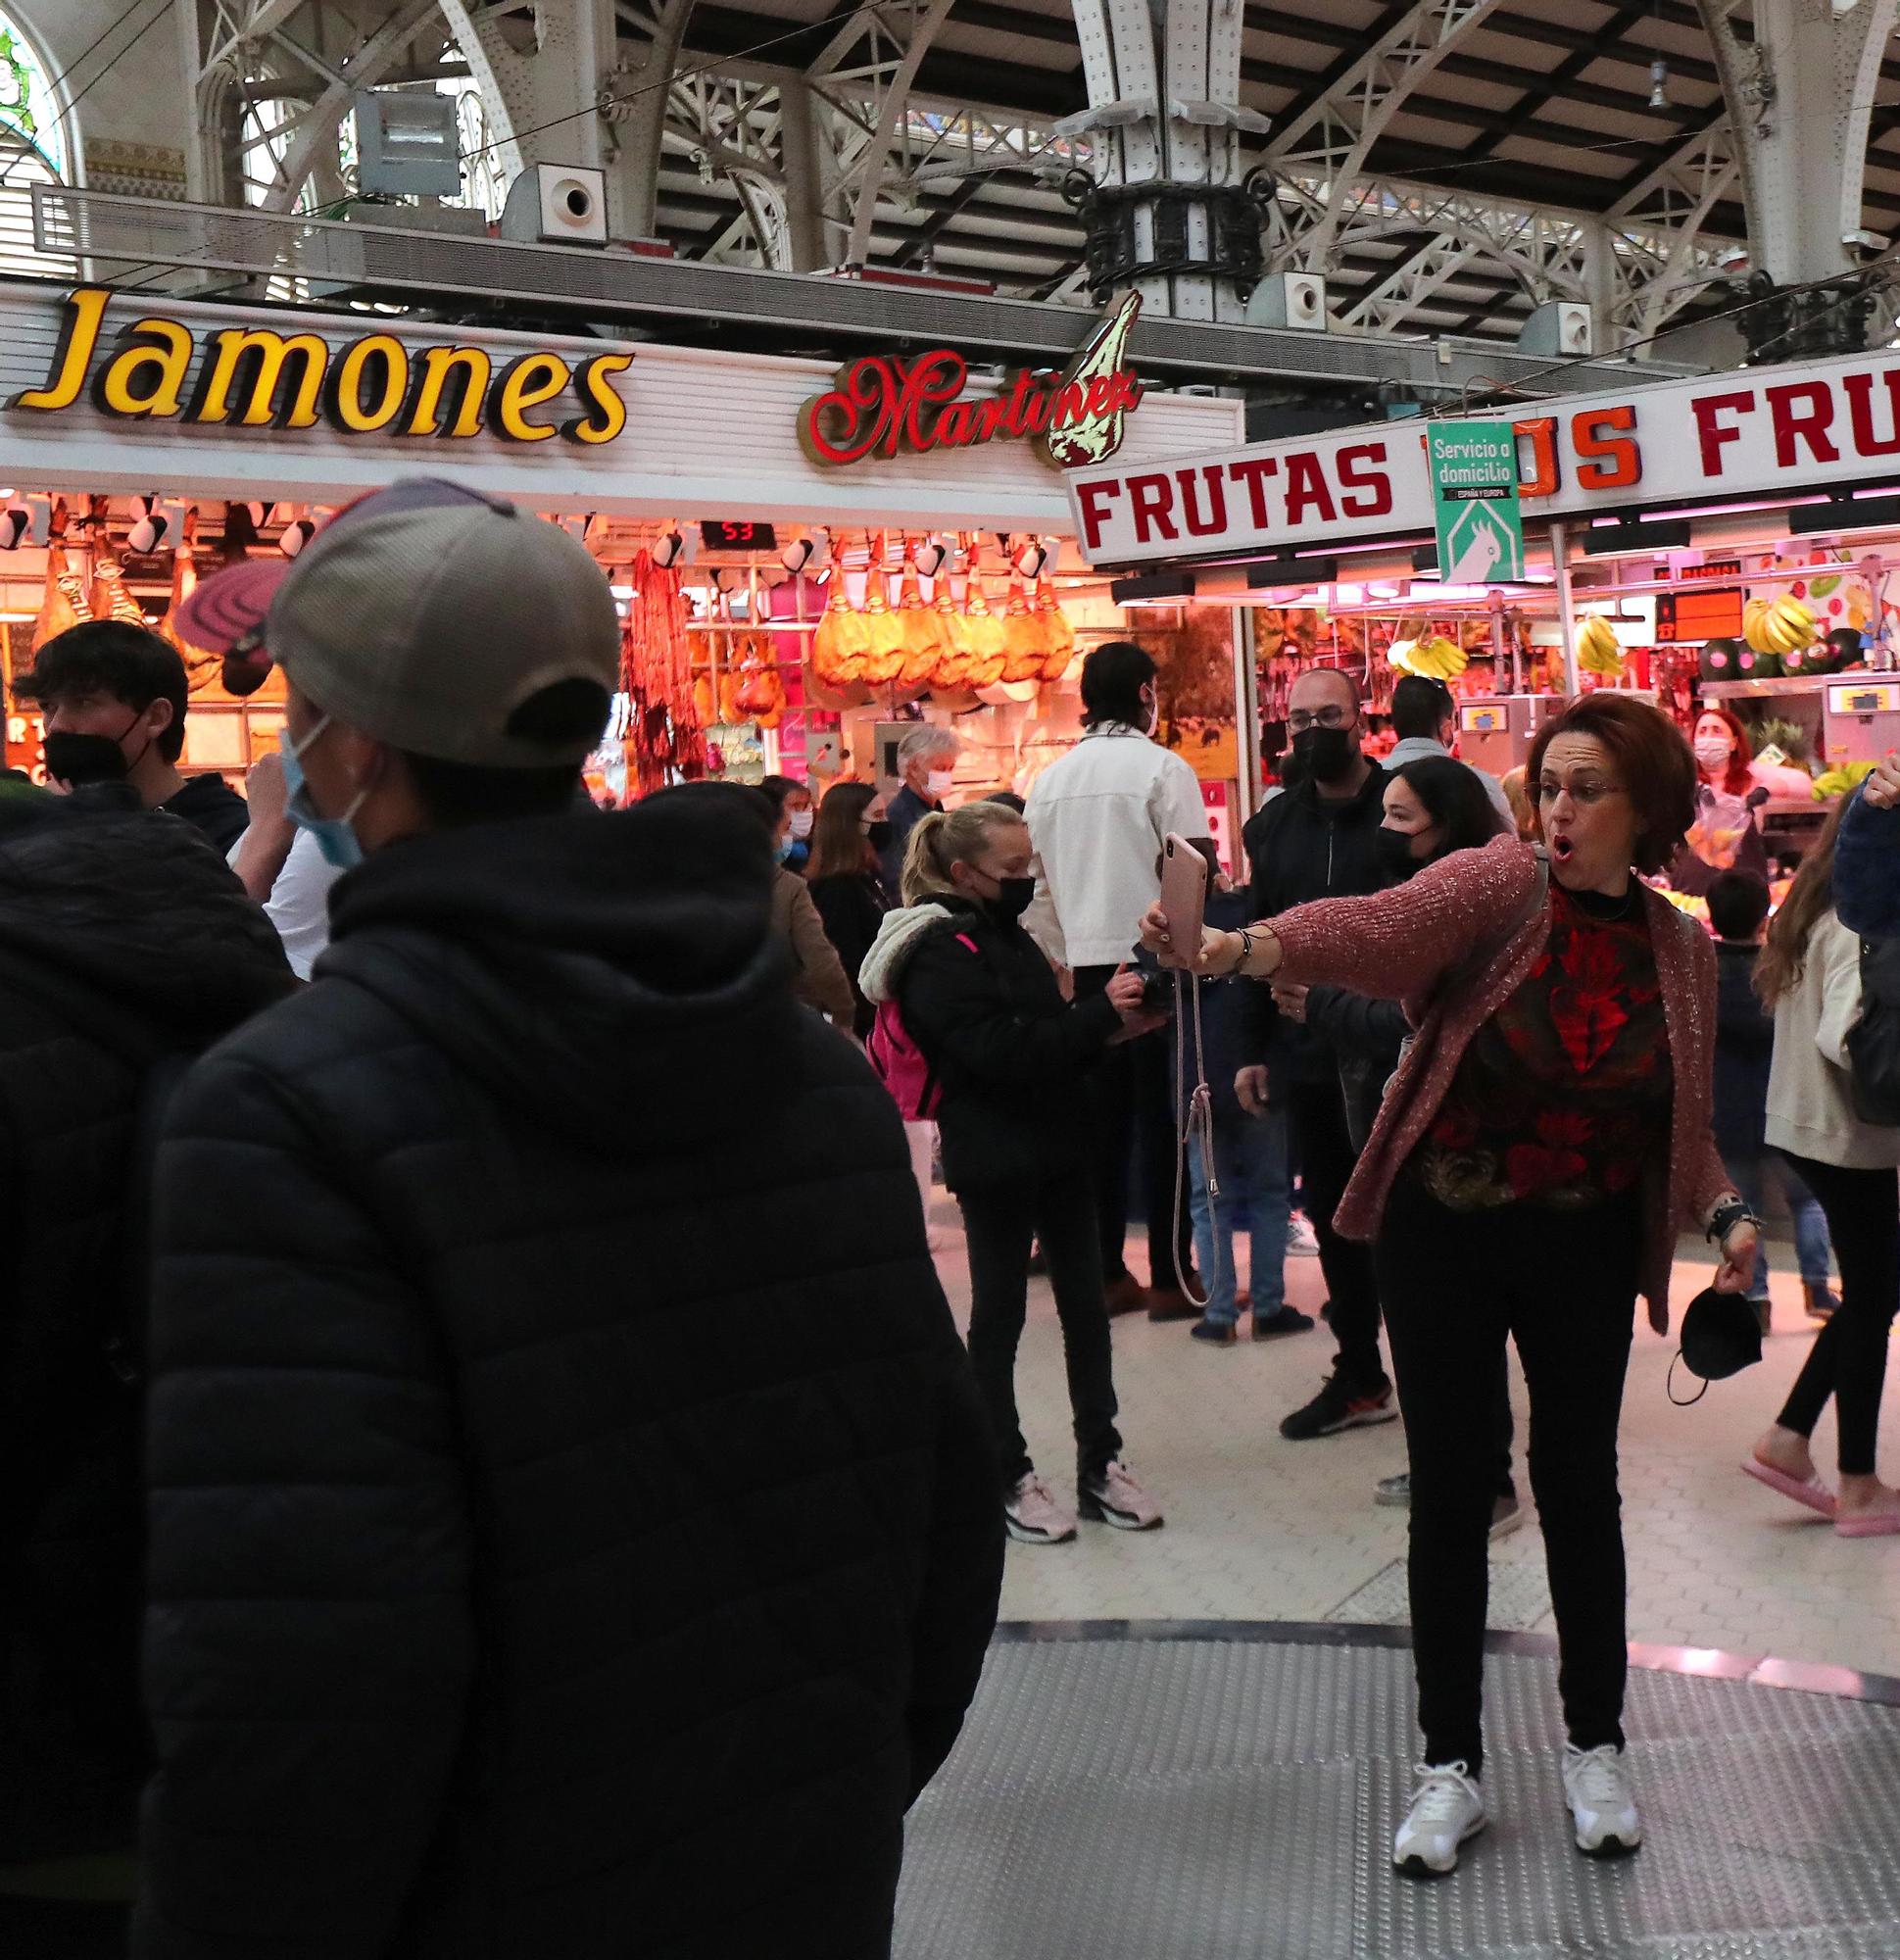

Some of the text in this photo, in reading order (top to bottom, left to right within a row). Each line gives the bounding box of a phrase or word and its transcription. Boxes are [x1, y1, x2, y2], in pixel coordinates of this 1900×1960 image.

[14, 288, 636, 445] Jamones
[1435, 438, 1497, 460] Servicio
[1439, 463, 1510, 483] domicilio
[1076, 442, 1392, 549] FRUTAS
[721, 520, 754, 541] 53
